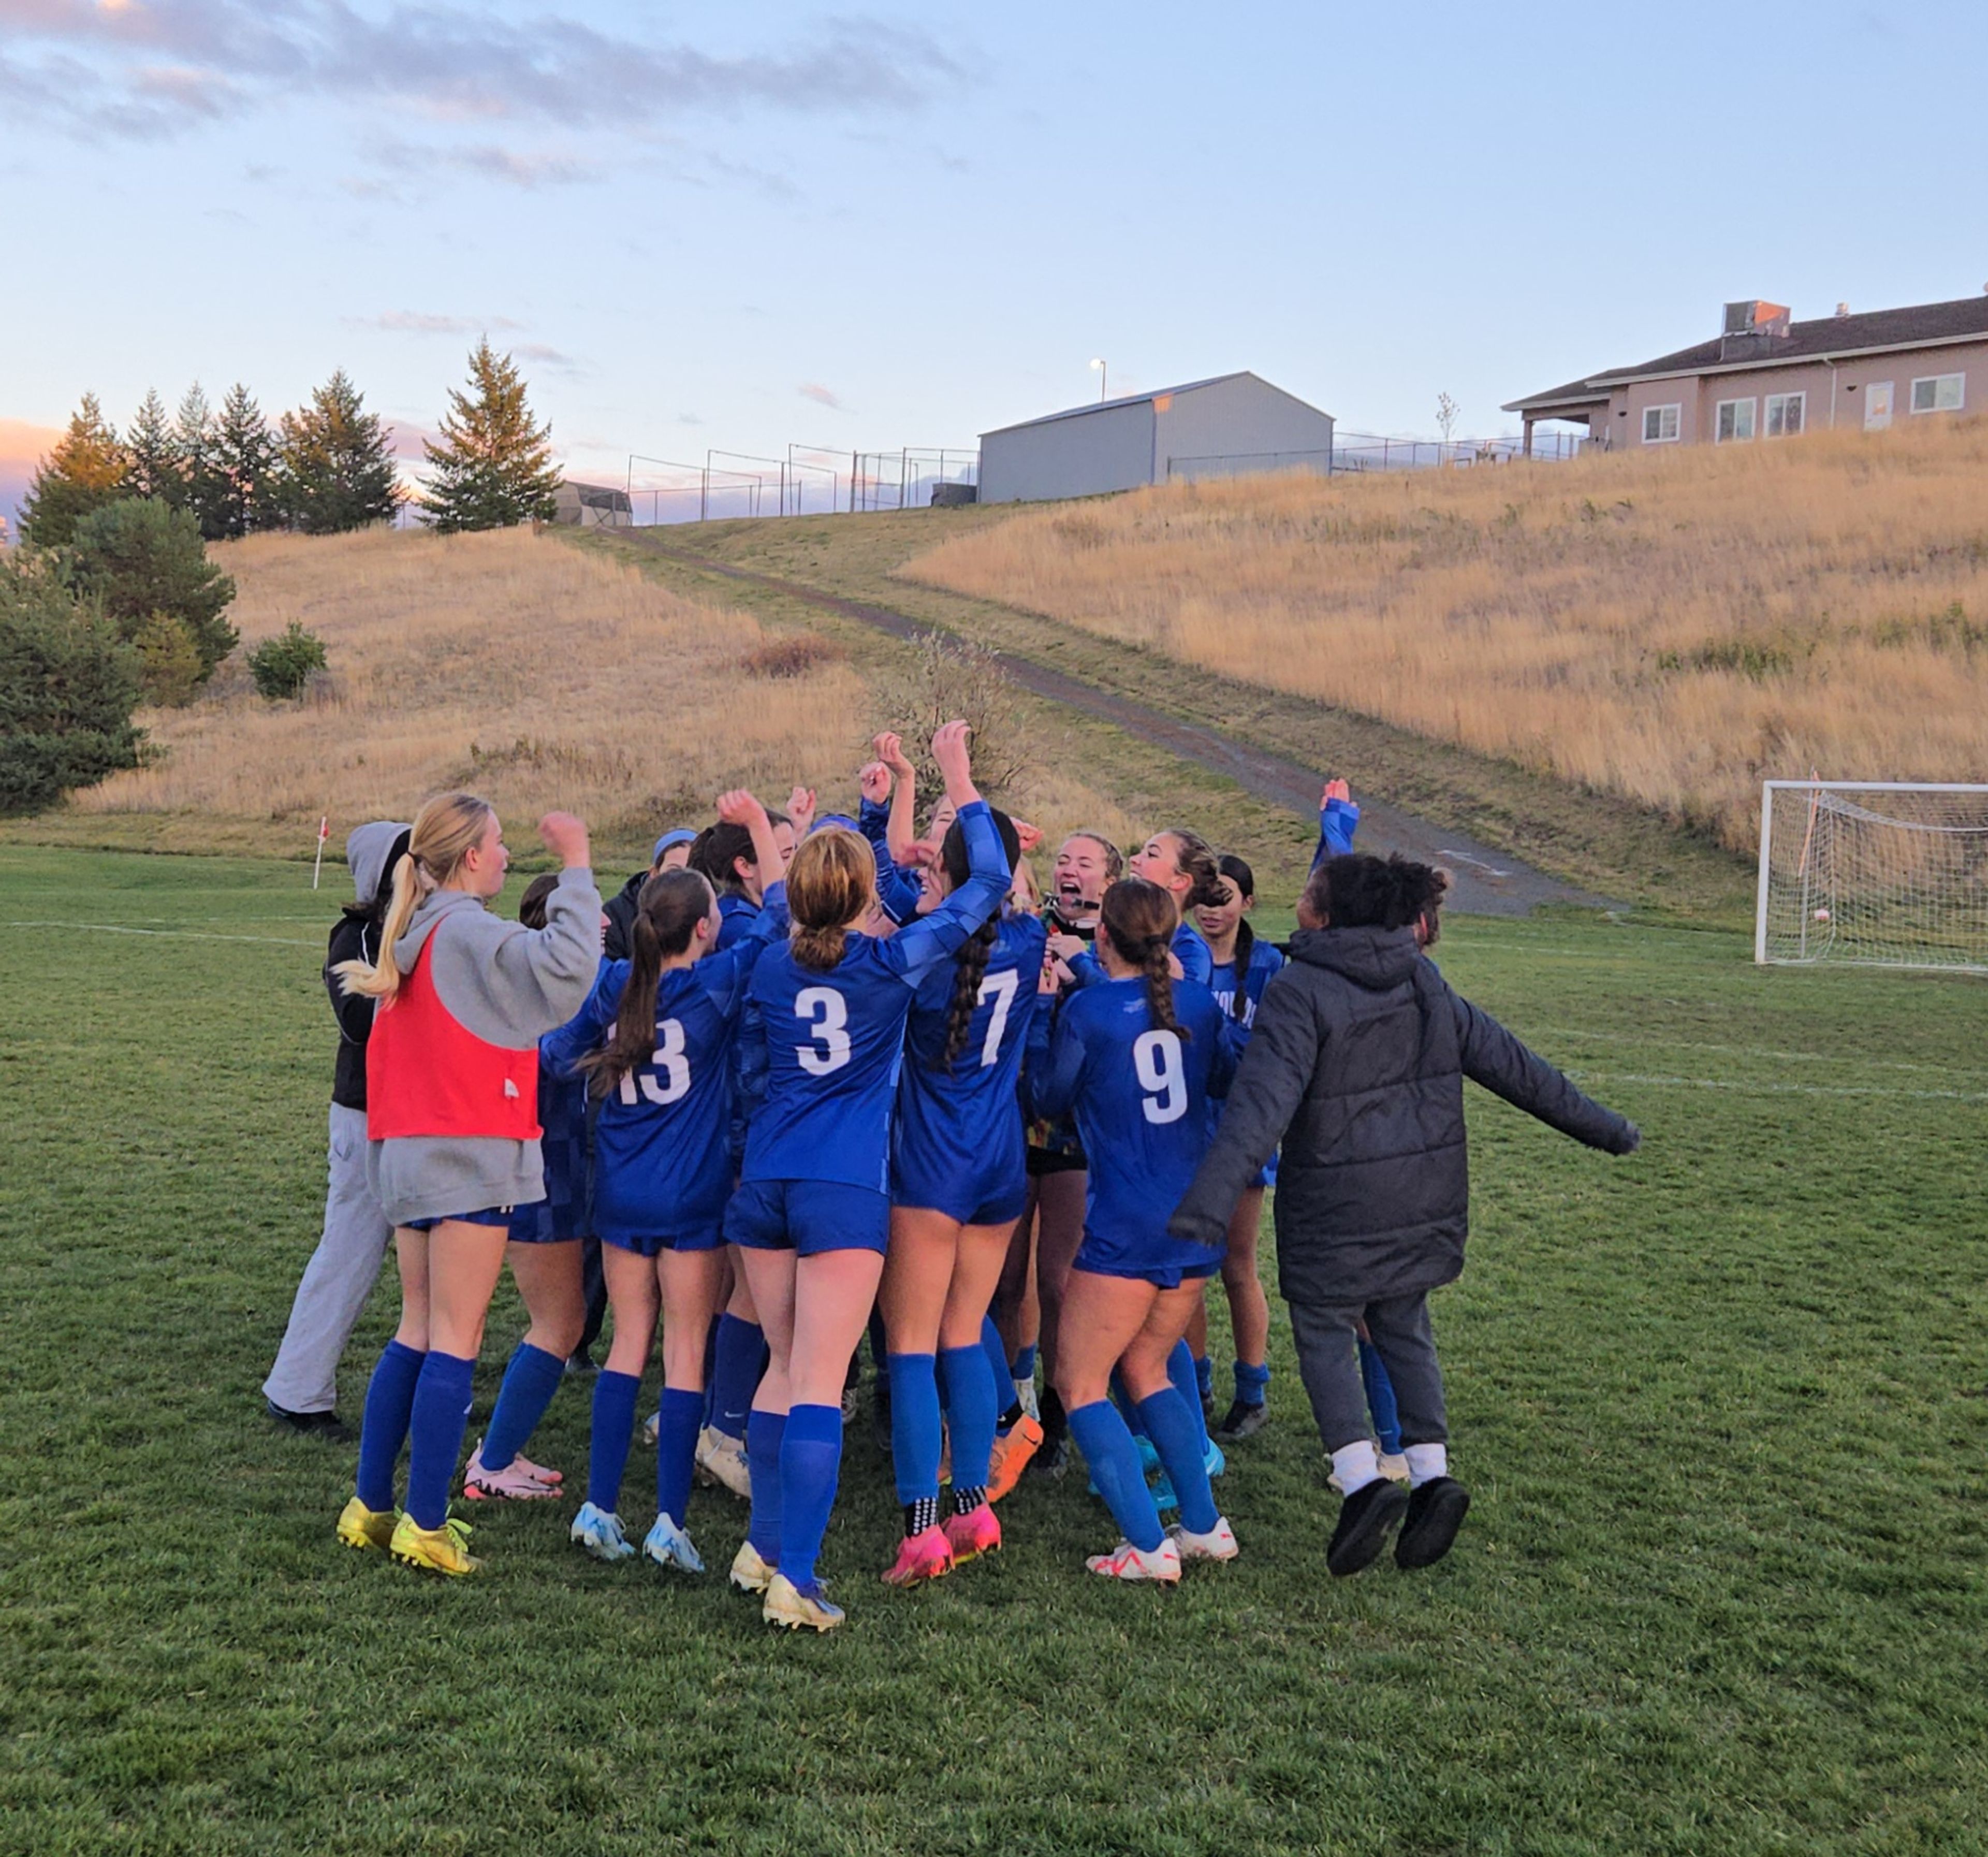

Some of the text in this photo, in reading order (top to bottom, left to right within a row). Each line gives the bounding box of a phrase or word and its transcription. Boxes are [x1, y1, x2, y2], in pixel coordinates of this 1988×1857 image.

[795, 987, 851, 1076] 3
[977, 968, 1019, 1067] 7
[1133, 1029, 1188, 1124] 9
